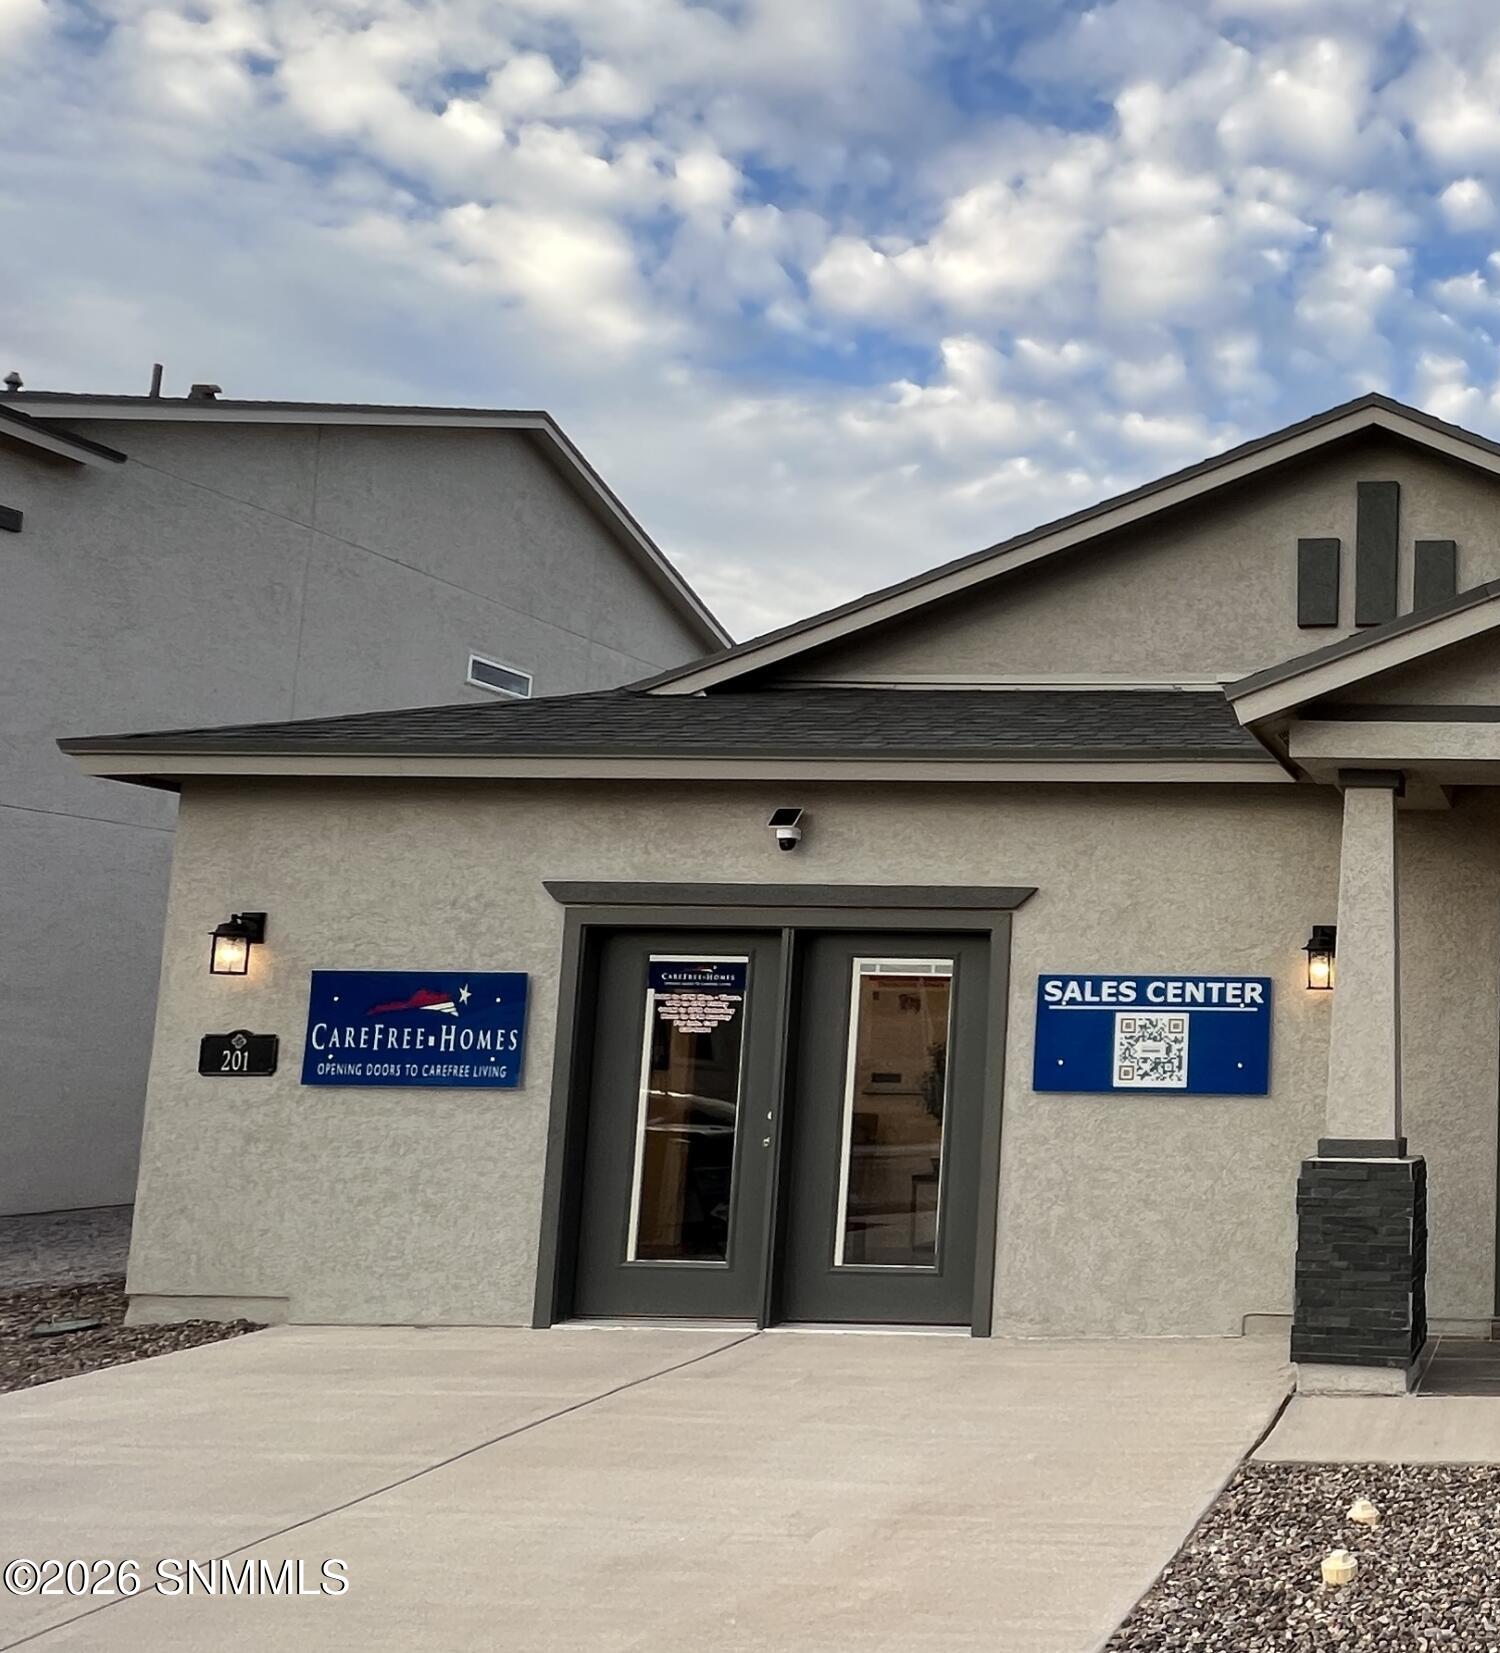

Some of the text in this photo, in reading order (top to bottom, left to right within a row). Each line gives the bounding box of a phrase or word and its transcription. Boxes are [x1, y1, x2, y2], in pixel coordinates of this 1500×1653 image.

[1044, 980, 1265, 1004] SALES CENTER
[221, 1050, 248, 1071] 201
[317, 1063, 507, 1078] OPENING DOORS TO CAREFREE LIVING
